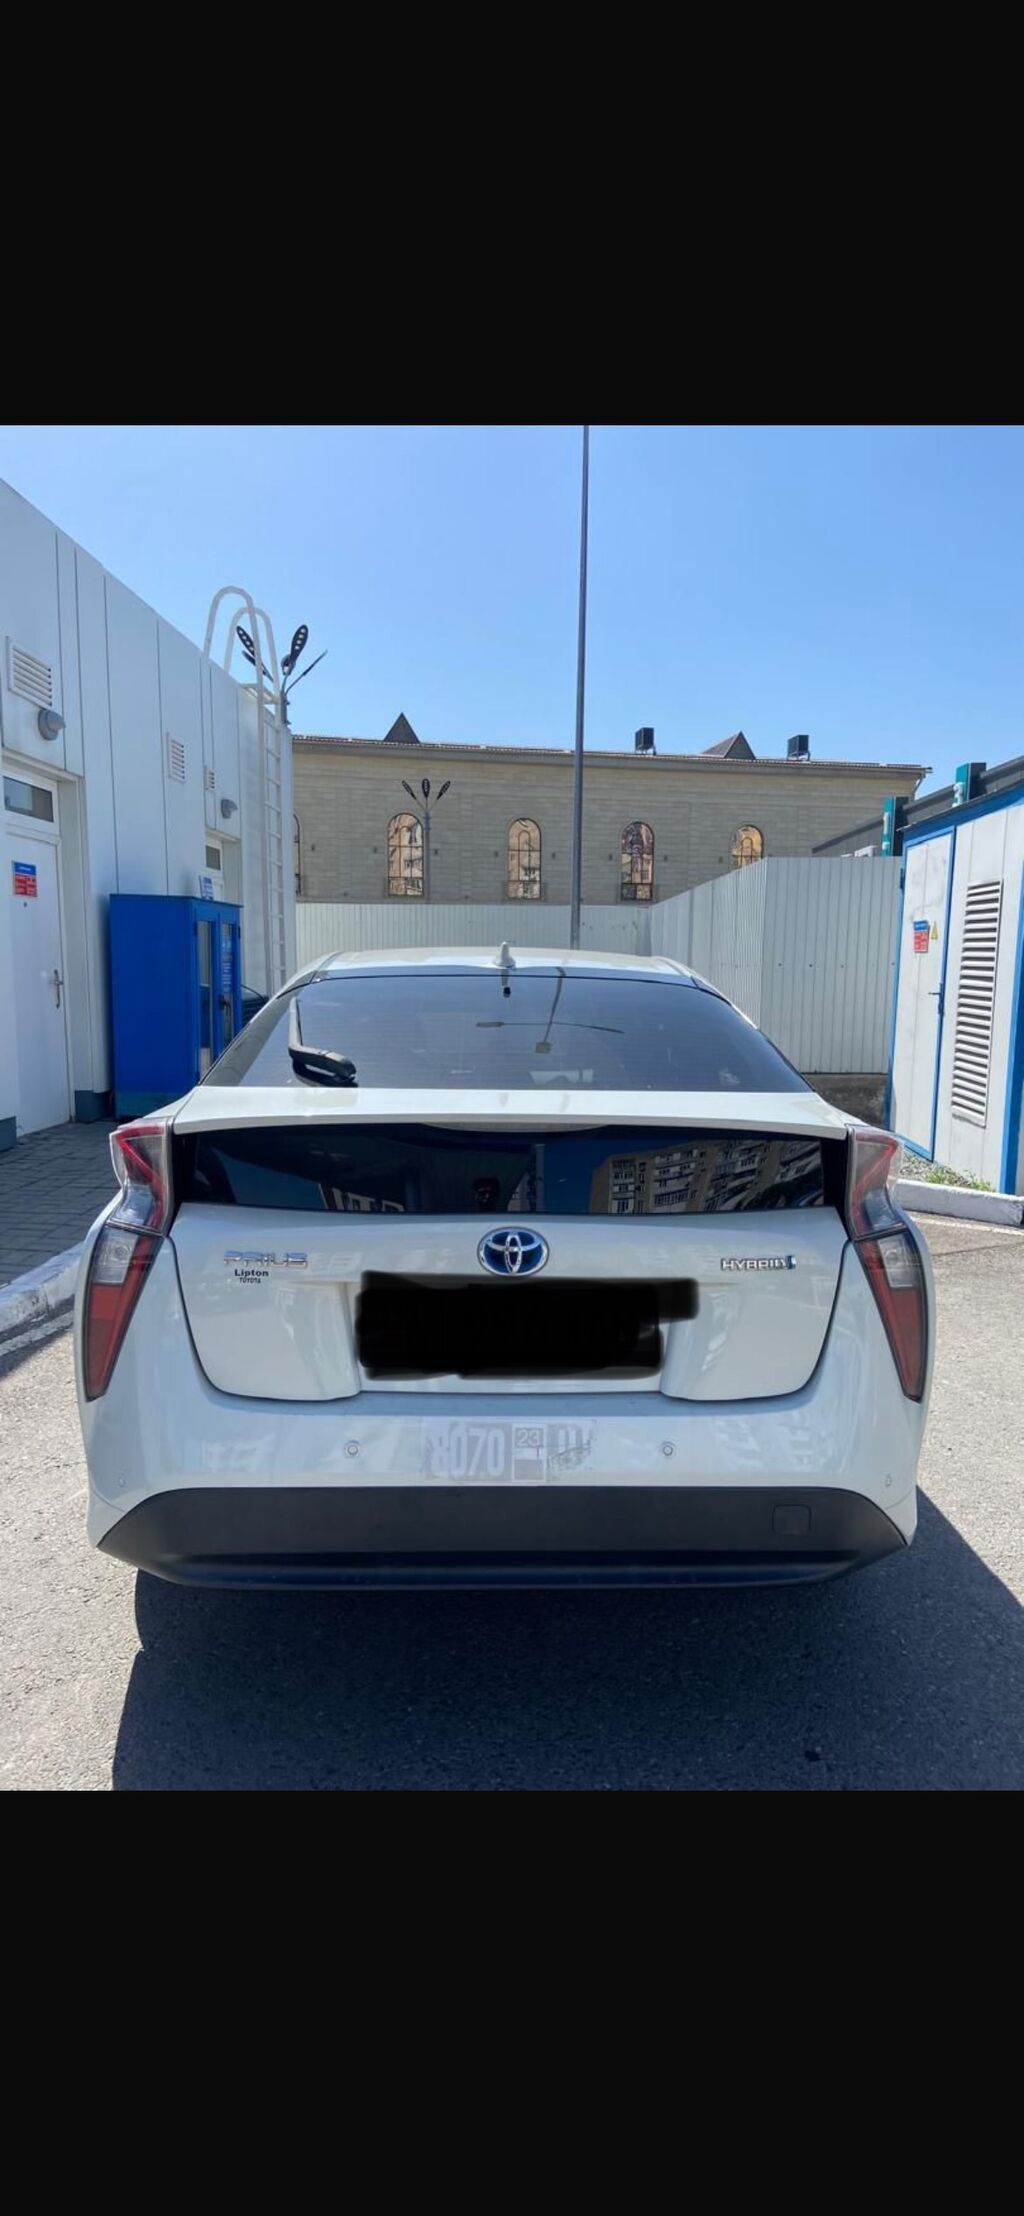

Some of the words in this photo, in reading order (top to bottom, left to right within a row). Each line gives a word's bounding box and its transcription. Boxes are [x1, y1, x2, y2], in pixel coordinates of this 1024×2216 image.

[223, 1250, 308, 1269] PRIUS
[720, 1257, 787, 1271] HYBRID
[234, 1269, 269, 1279] Lipton
